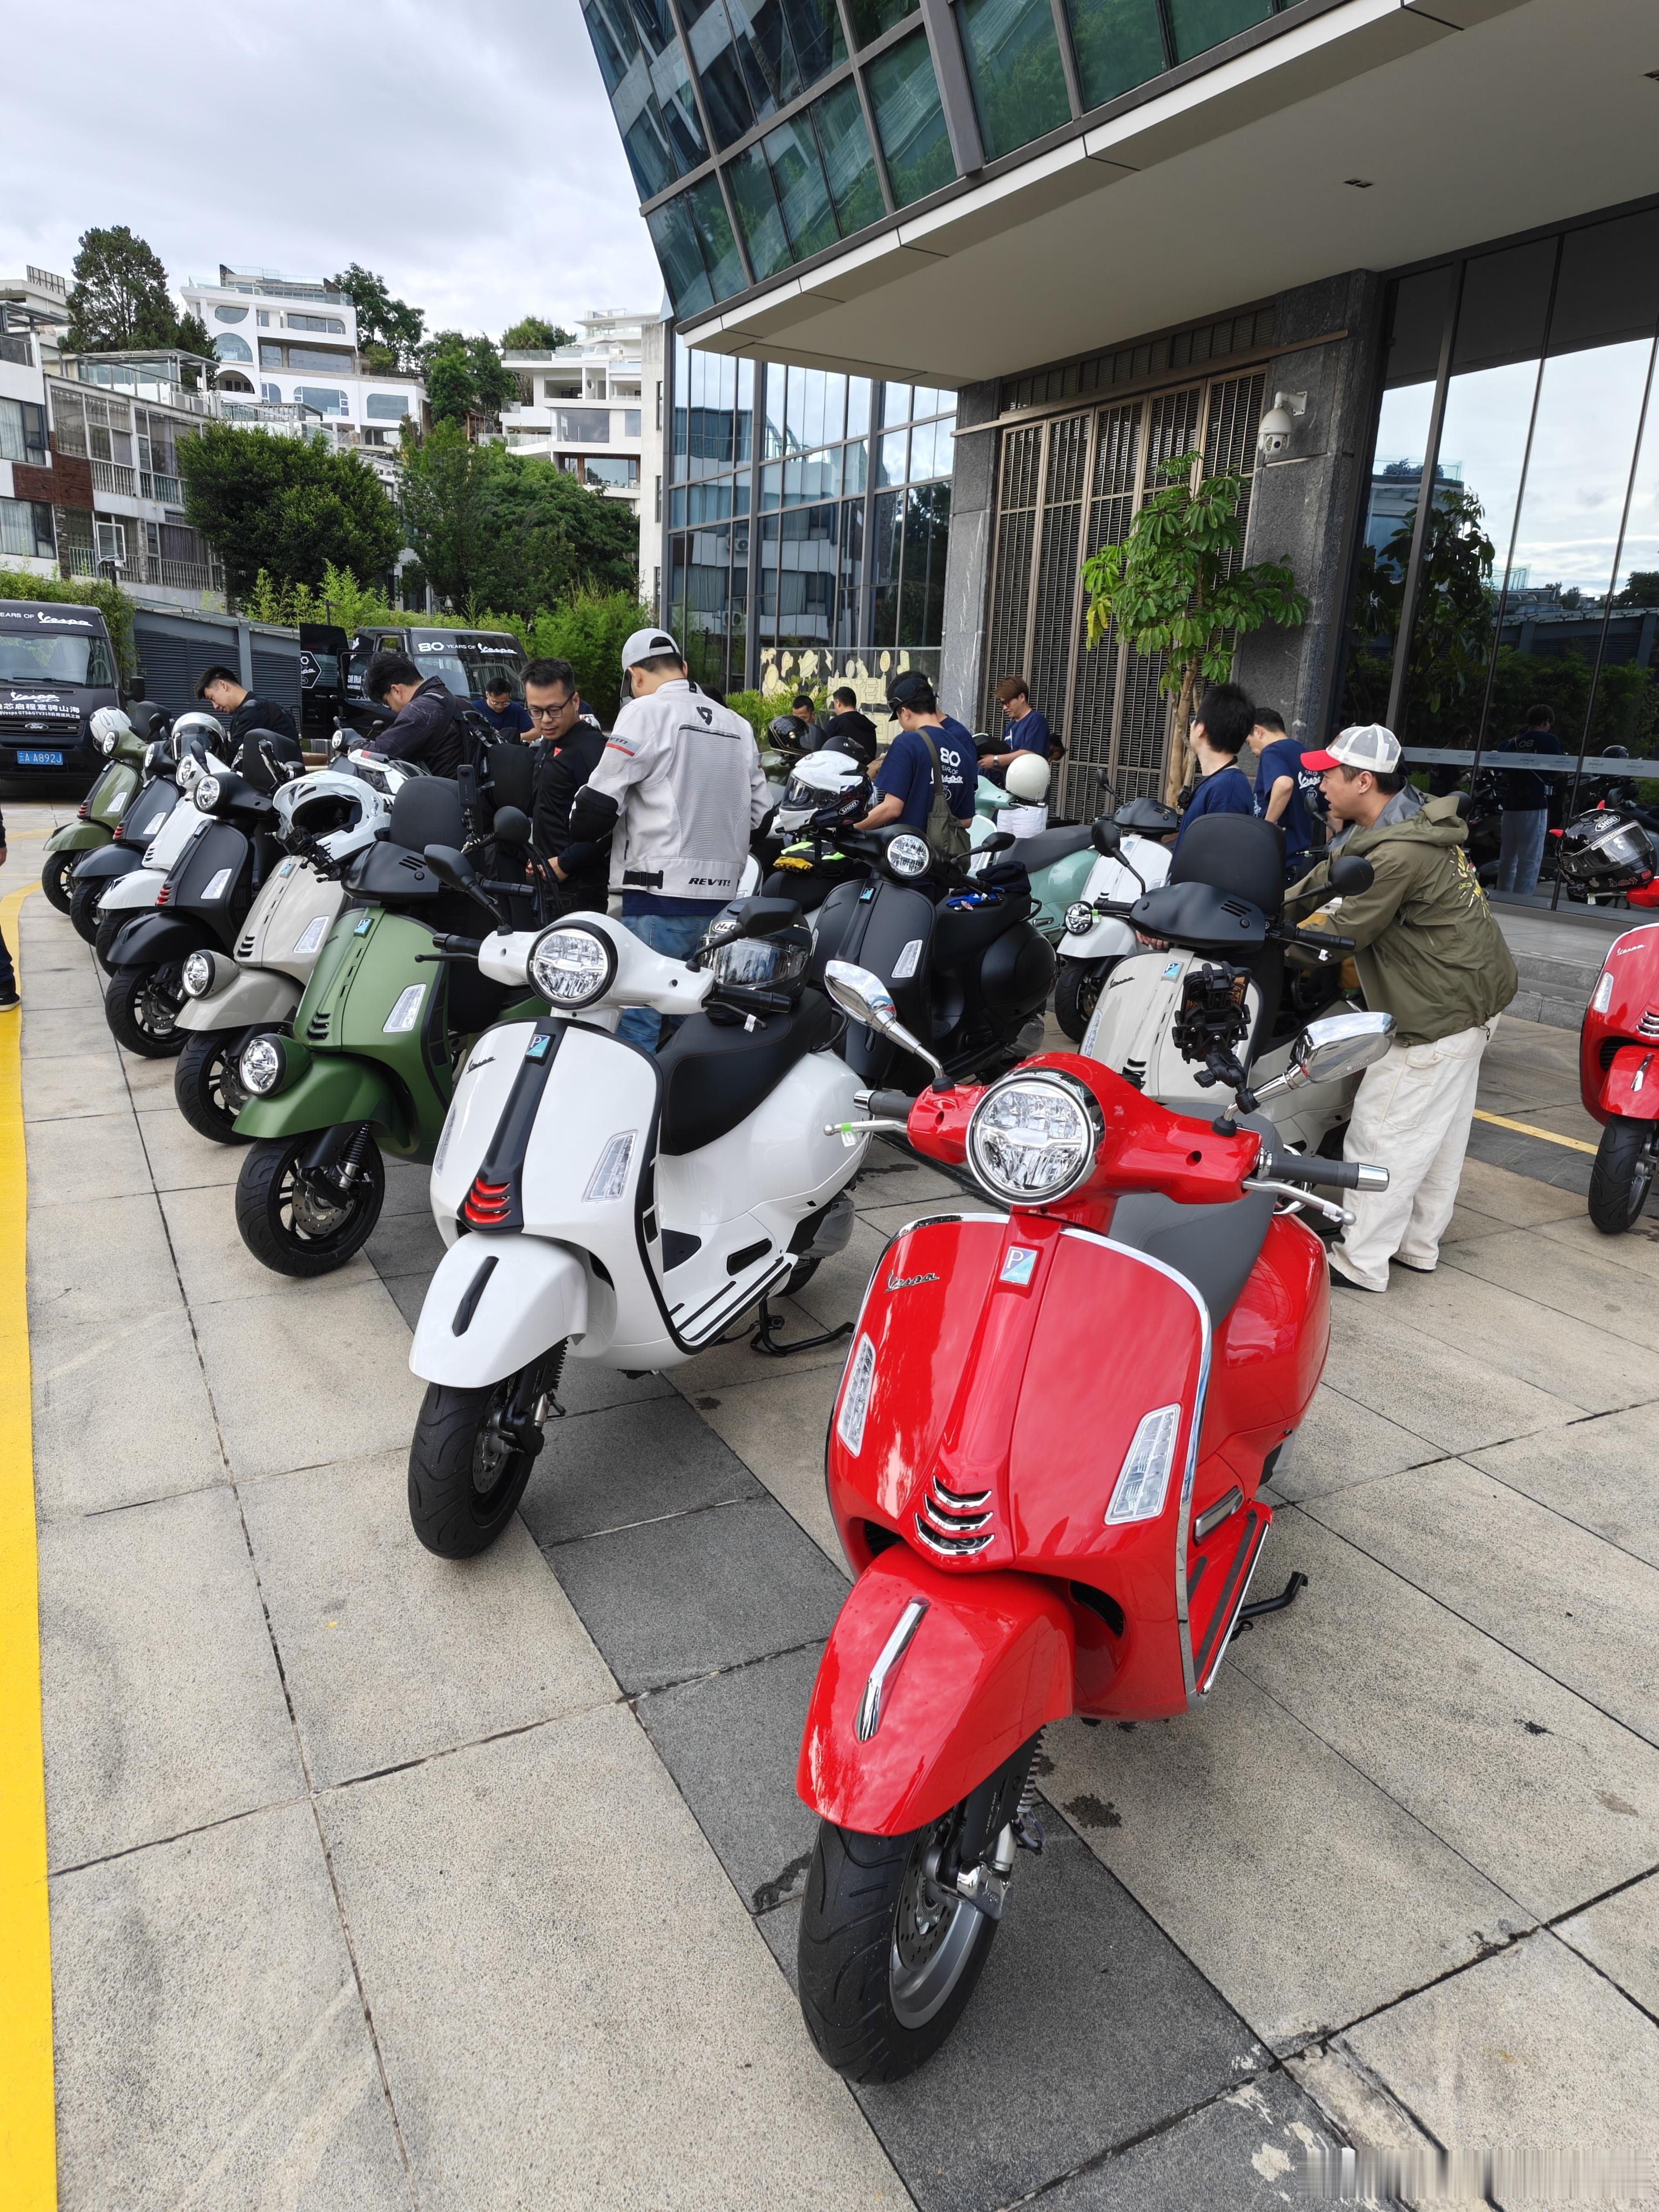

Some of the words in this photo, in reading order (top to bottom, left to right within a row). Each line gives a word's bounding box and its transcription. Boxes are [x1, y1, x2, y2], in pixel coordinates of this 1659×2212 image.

[37, 611, 93, 627] Vespa
[418, 642, 444, 652] 80
[477, 643, 518, 655] Vespa
[10, 691, 60, 701] Vespa
[33, 753, 62, 763] A892J
[940, 747, 961, 767] 80
[841, 801, 858, 813] SHOEI
[1597, 816, 1618, 830] SHOEI
[688, 878, 731, 886] REV'IT!
[530, 1036, 542, 1048] P
[1006, 1249, 1024, 1269] P
[884, 1269, 940, 1294] Vespa
